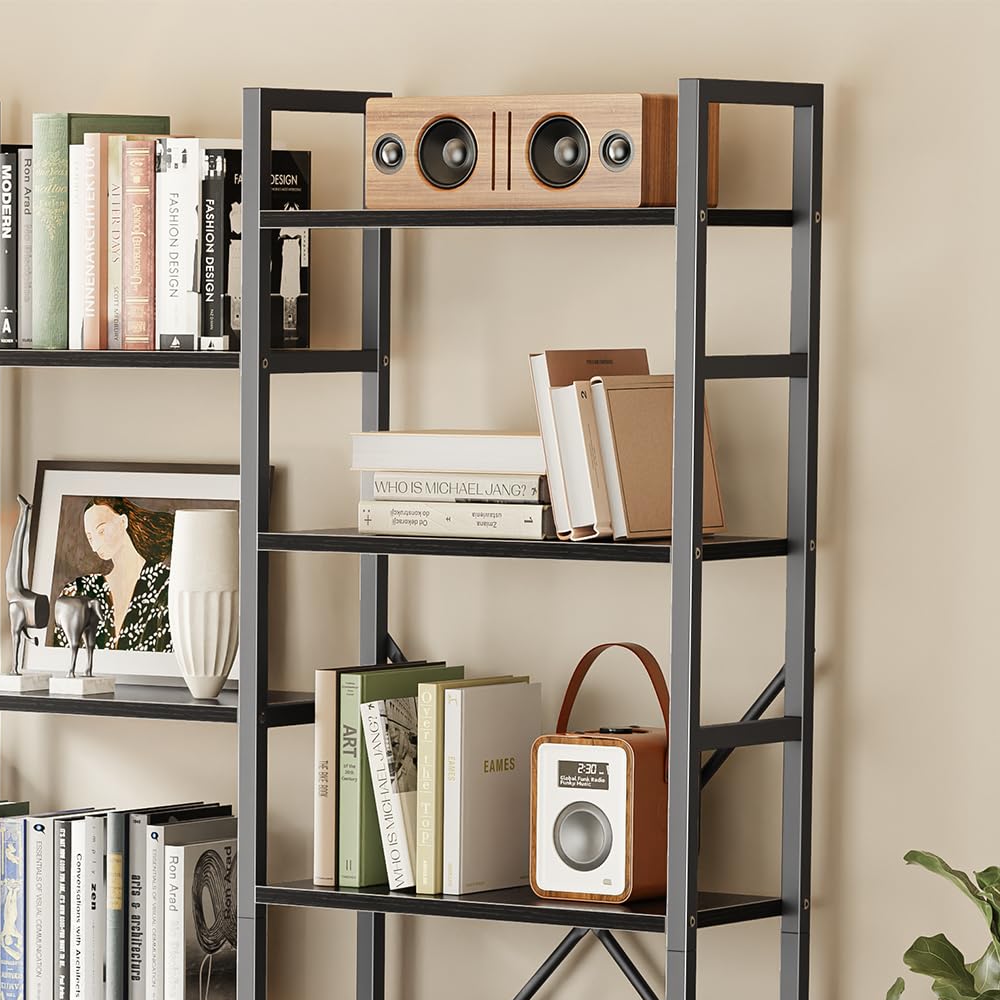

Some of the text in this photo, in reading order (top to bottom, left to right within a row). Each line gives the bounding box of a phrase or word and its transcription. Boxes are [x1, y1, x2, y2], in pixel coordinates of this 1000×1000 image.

[24, 158, 32, 183] Ron
[2, 164, 12, 238] MODERN
[24, 188, 32, 216] Arad
[86, 146, 96, 318] INNENARCHITEKTUR
[169, 192, 179, 298] FASHION DESIGN
[206, 200, 214, 252] FASHION
[206, 257, 214, 302] DESIGN
[374, 481, 526, 497] WHO IS MICHAEL JANG?
[343, 724, 358, 758] ART
[484, 758, 516, 774] EAMES
[578, 763, 597, 774] 2:30
[368, 716, 404, 888] WHO IS MICHAEL JANG?
[132, 874, 142, 896] arts
[169, 856, 178, 912] Ron Arad
[132, 914, 142, 981] architecture
